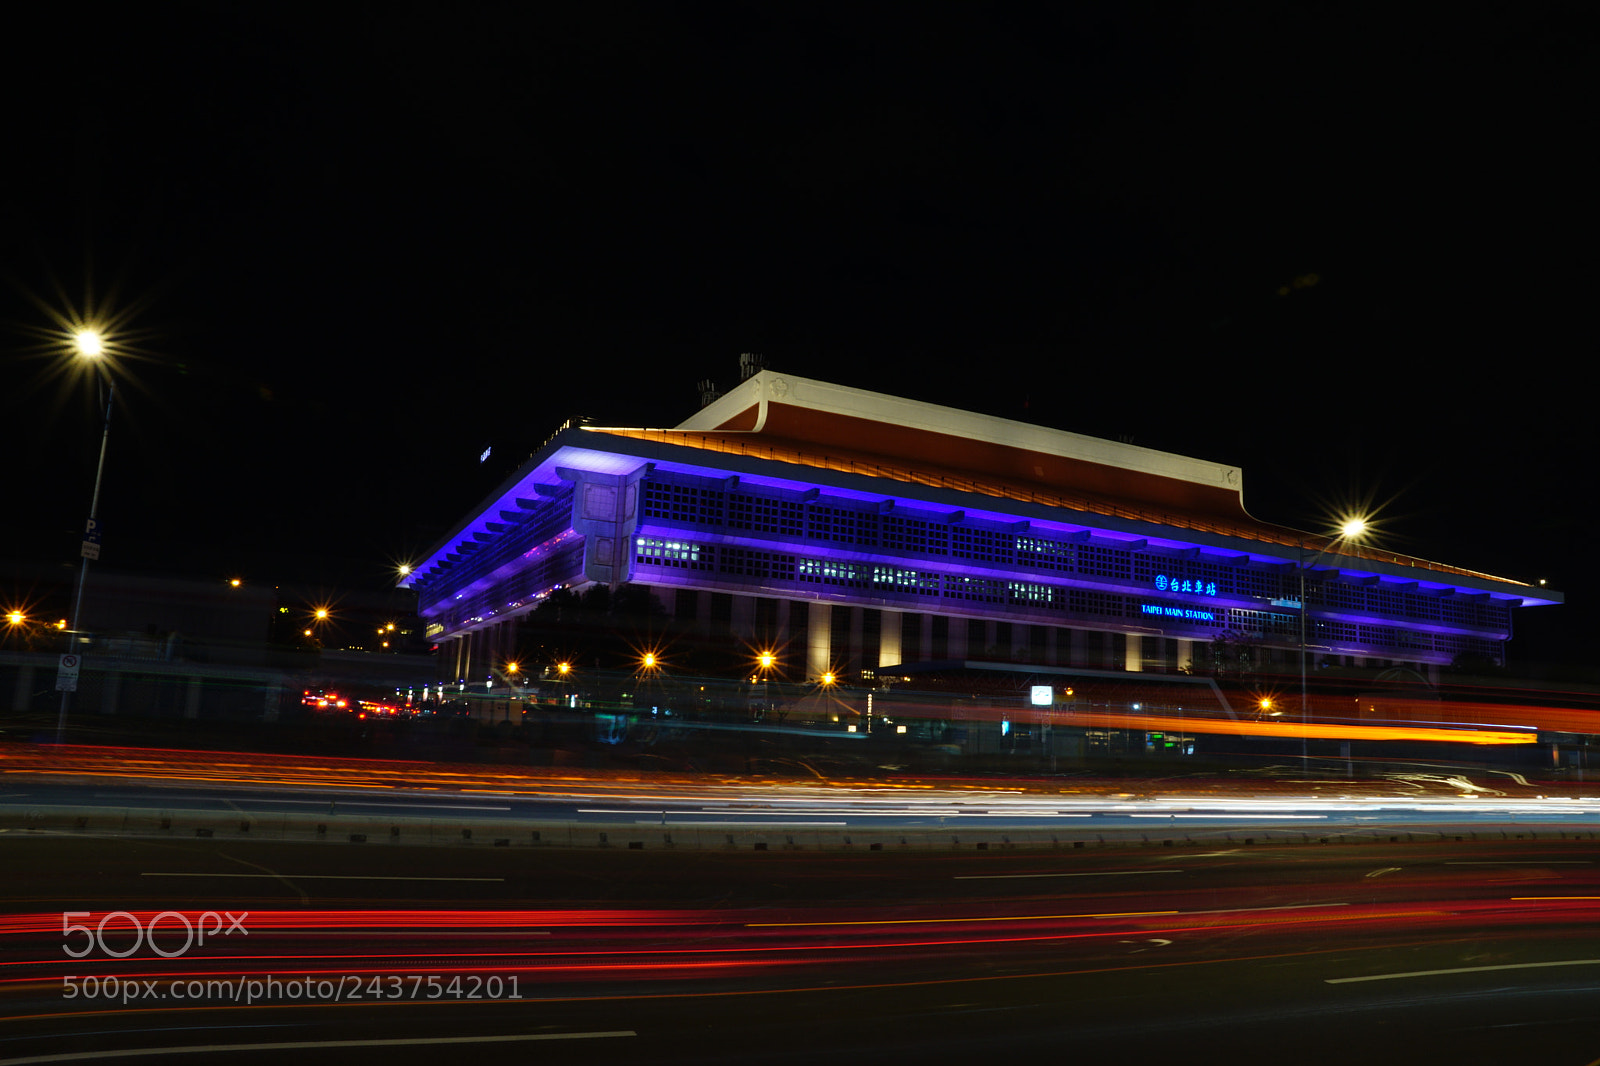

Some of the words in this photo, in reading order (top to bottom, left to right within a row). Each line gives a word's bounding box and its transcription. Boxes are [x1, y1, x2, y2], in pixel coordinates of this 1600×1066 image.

[85, 519, 96, 534] P
[1170, 577, 1217, 596] 台北車站
[1141, 604, 1163, 615] TAIPEI
[1164, 607, 1184, 617] MAIN
[1185, 609, 1214, 621] STATION
